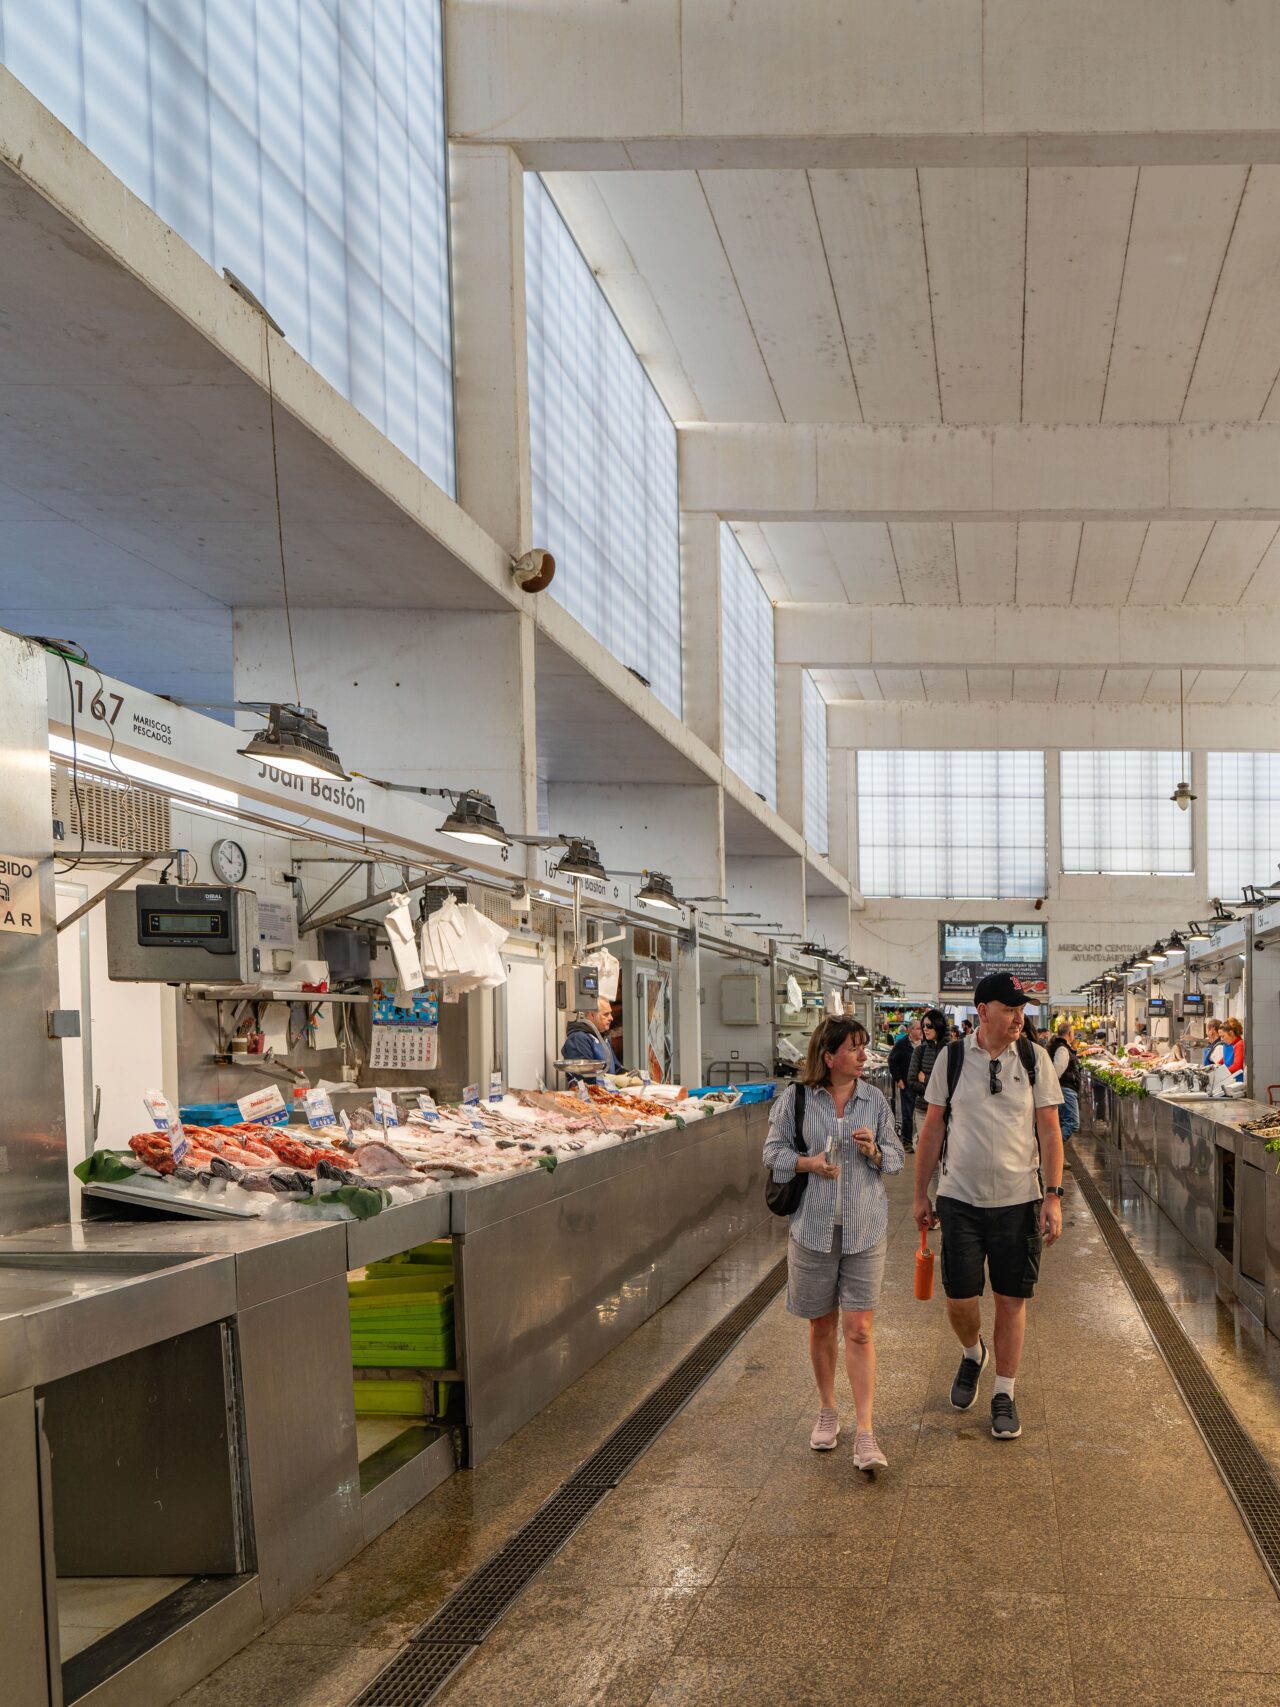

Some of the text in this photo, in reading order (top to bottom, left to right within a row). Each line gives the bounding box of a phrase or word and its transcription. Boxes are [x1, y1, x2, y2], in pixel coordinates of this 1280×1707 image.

[74, 679, 124, 725] 167
[132, 713, 172, 734] MARISCOS
[132, 724, 172, 745] PESCADOS
[258, 763, 365, 813] Juan Bastón
[1058, 943, 1103, 952] MERCADO
[1105, 943, 1142, 952] CENTRAL
